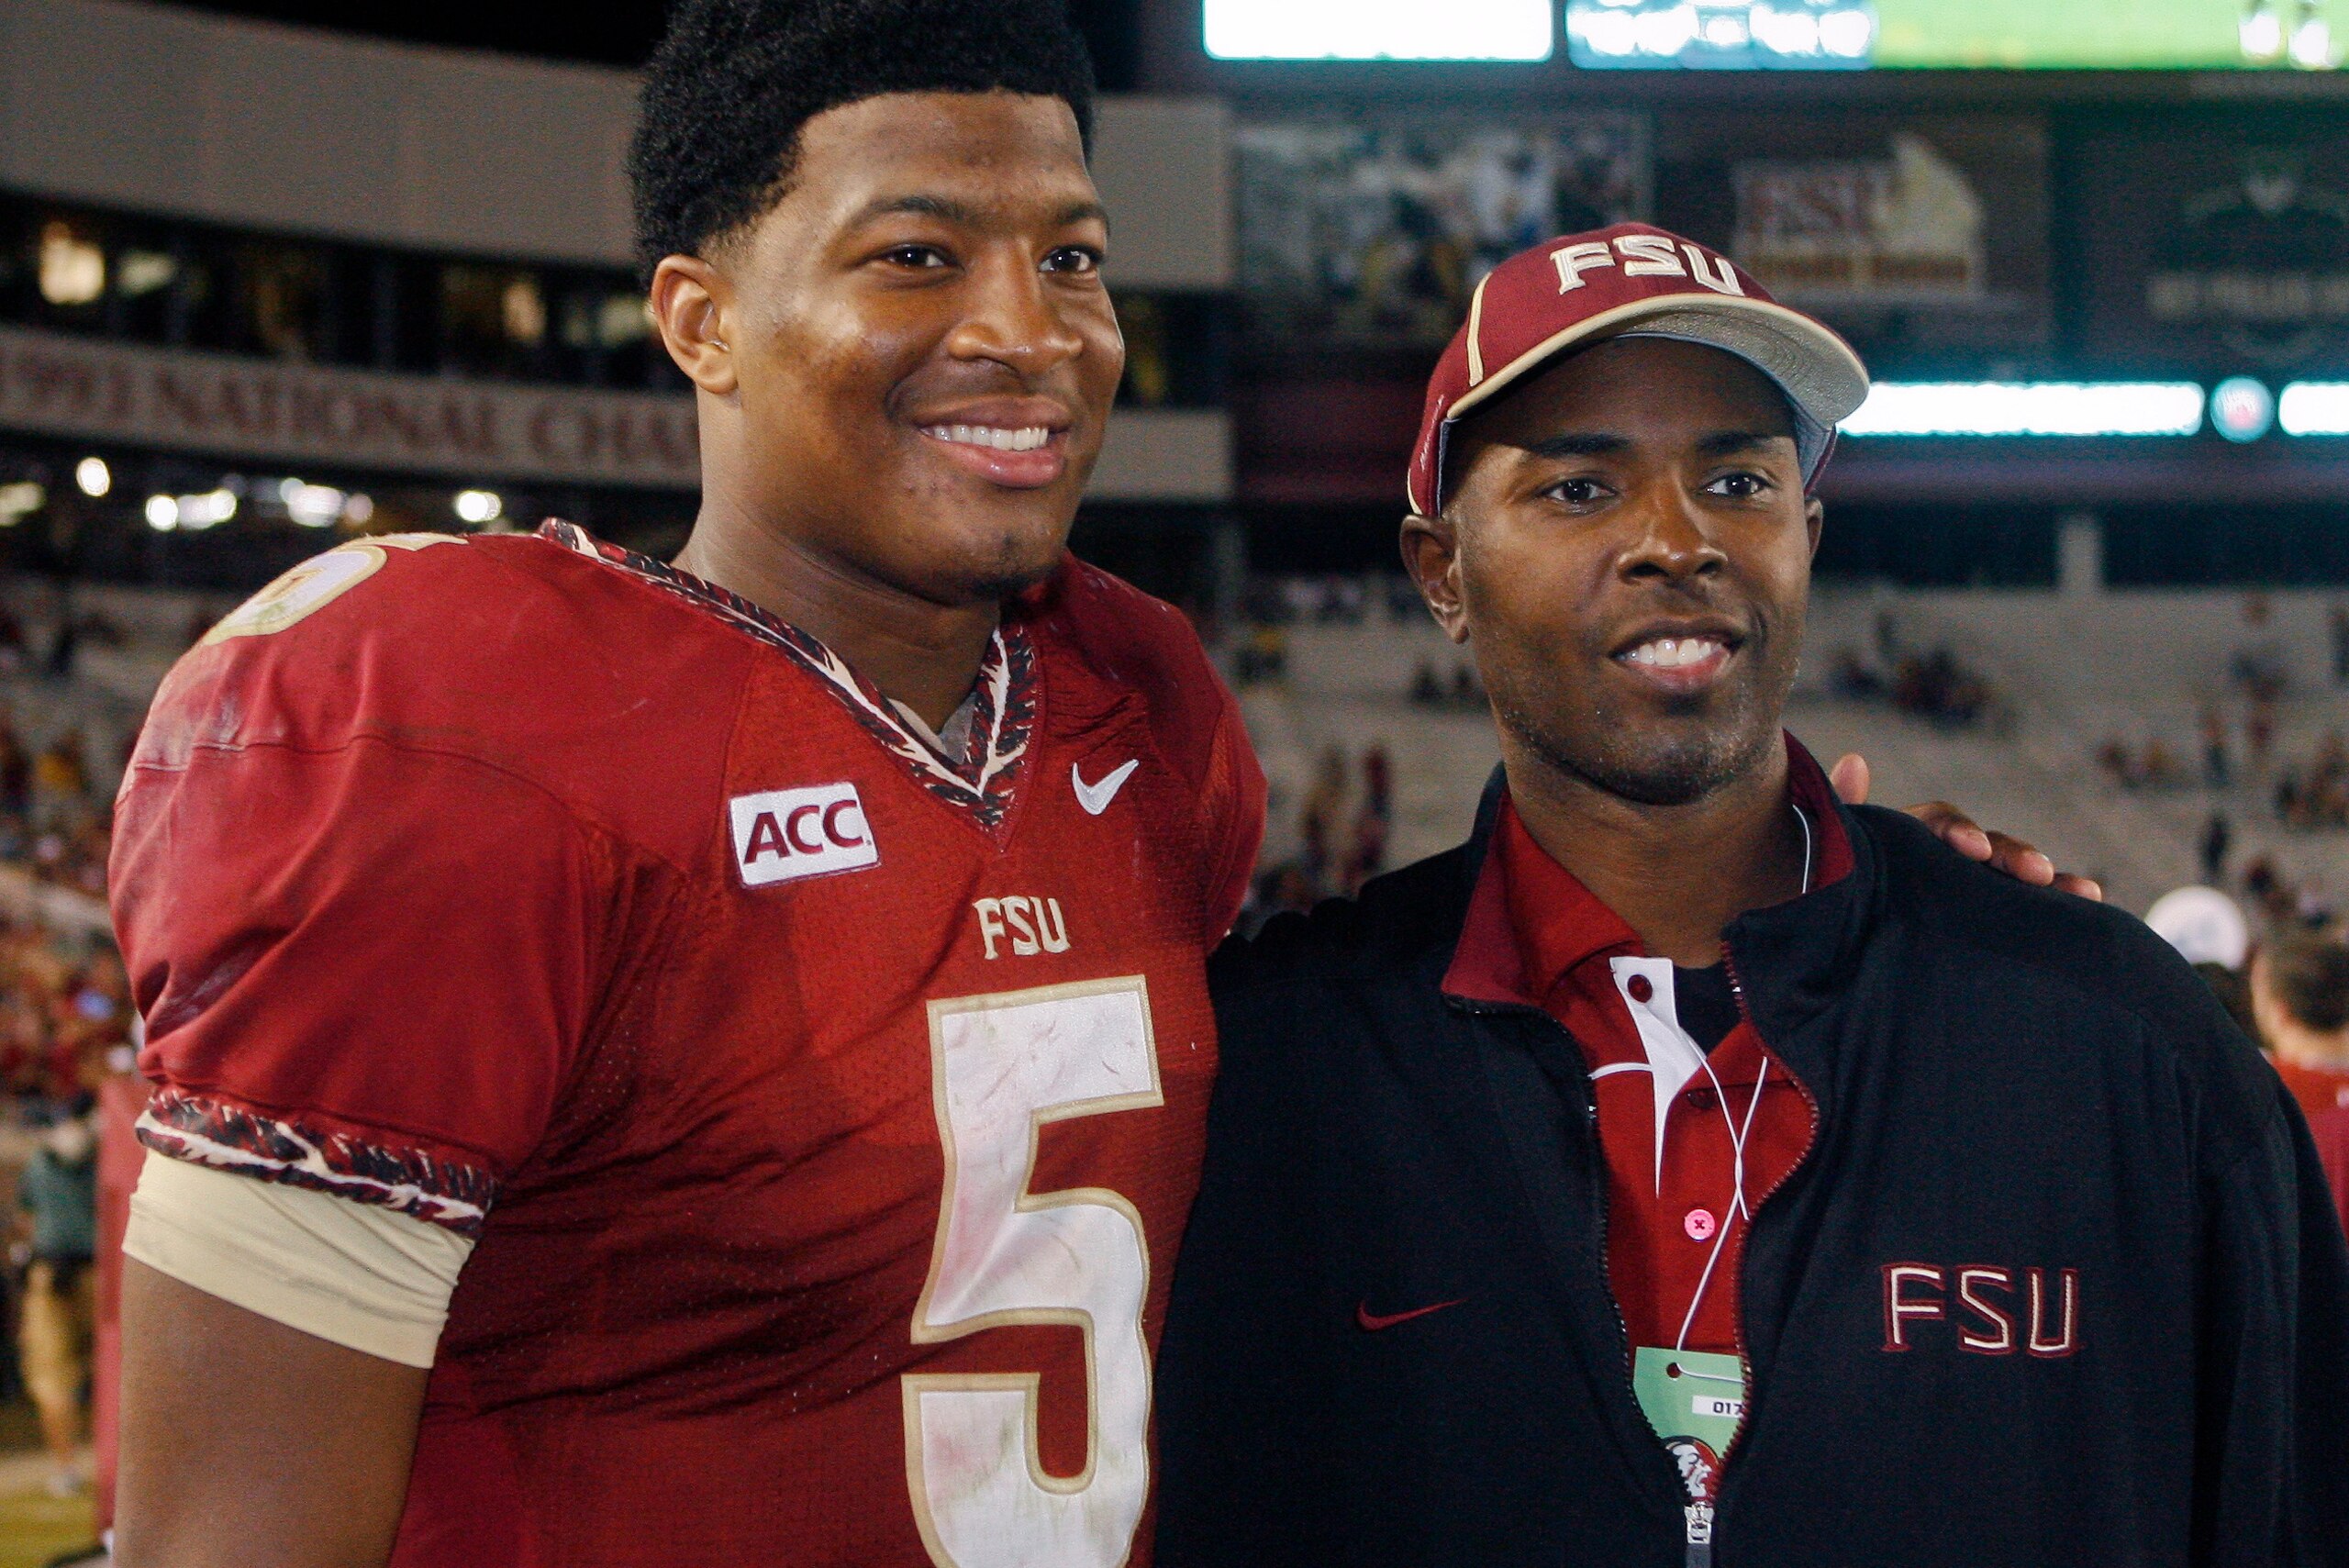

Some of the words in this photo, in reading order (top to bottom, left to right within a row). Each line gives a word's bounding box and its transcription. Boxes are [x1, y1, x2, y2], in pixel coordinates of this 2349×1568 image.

[1549, 235, 1744, 295] FSU
[149, 363, 507, 455] NATIONAL
[744, 799, 864, 864] ACC
[972, 895, 1071, 960] FSU
[901, 974, 1164, 1568] 5
[1881, 1261, 2081, 1359] FSU
